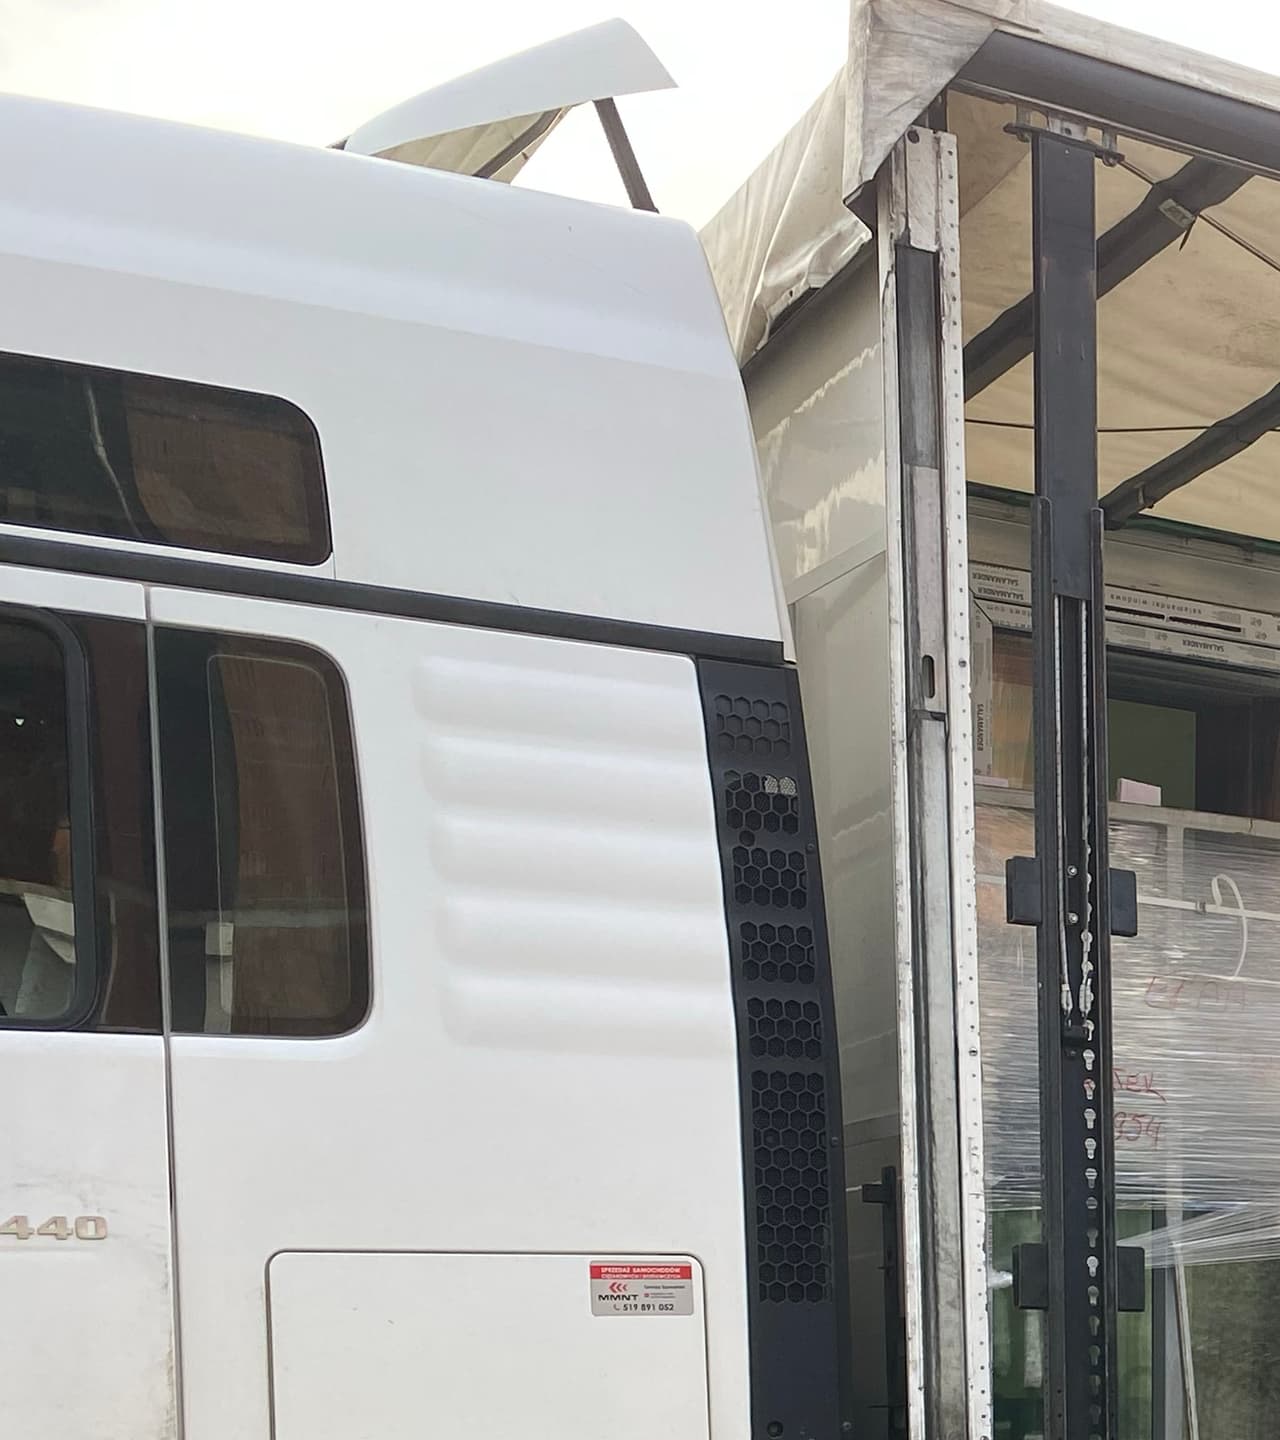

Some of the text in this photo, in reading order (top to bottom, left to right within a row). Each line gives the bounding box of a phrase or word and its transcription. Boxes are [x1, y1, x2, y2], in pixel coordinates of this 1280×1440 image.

[623, 1303, 674, 1311] 519 891 052
